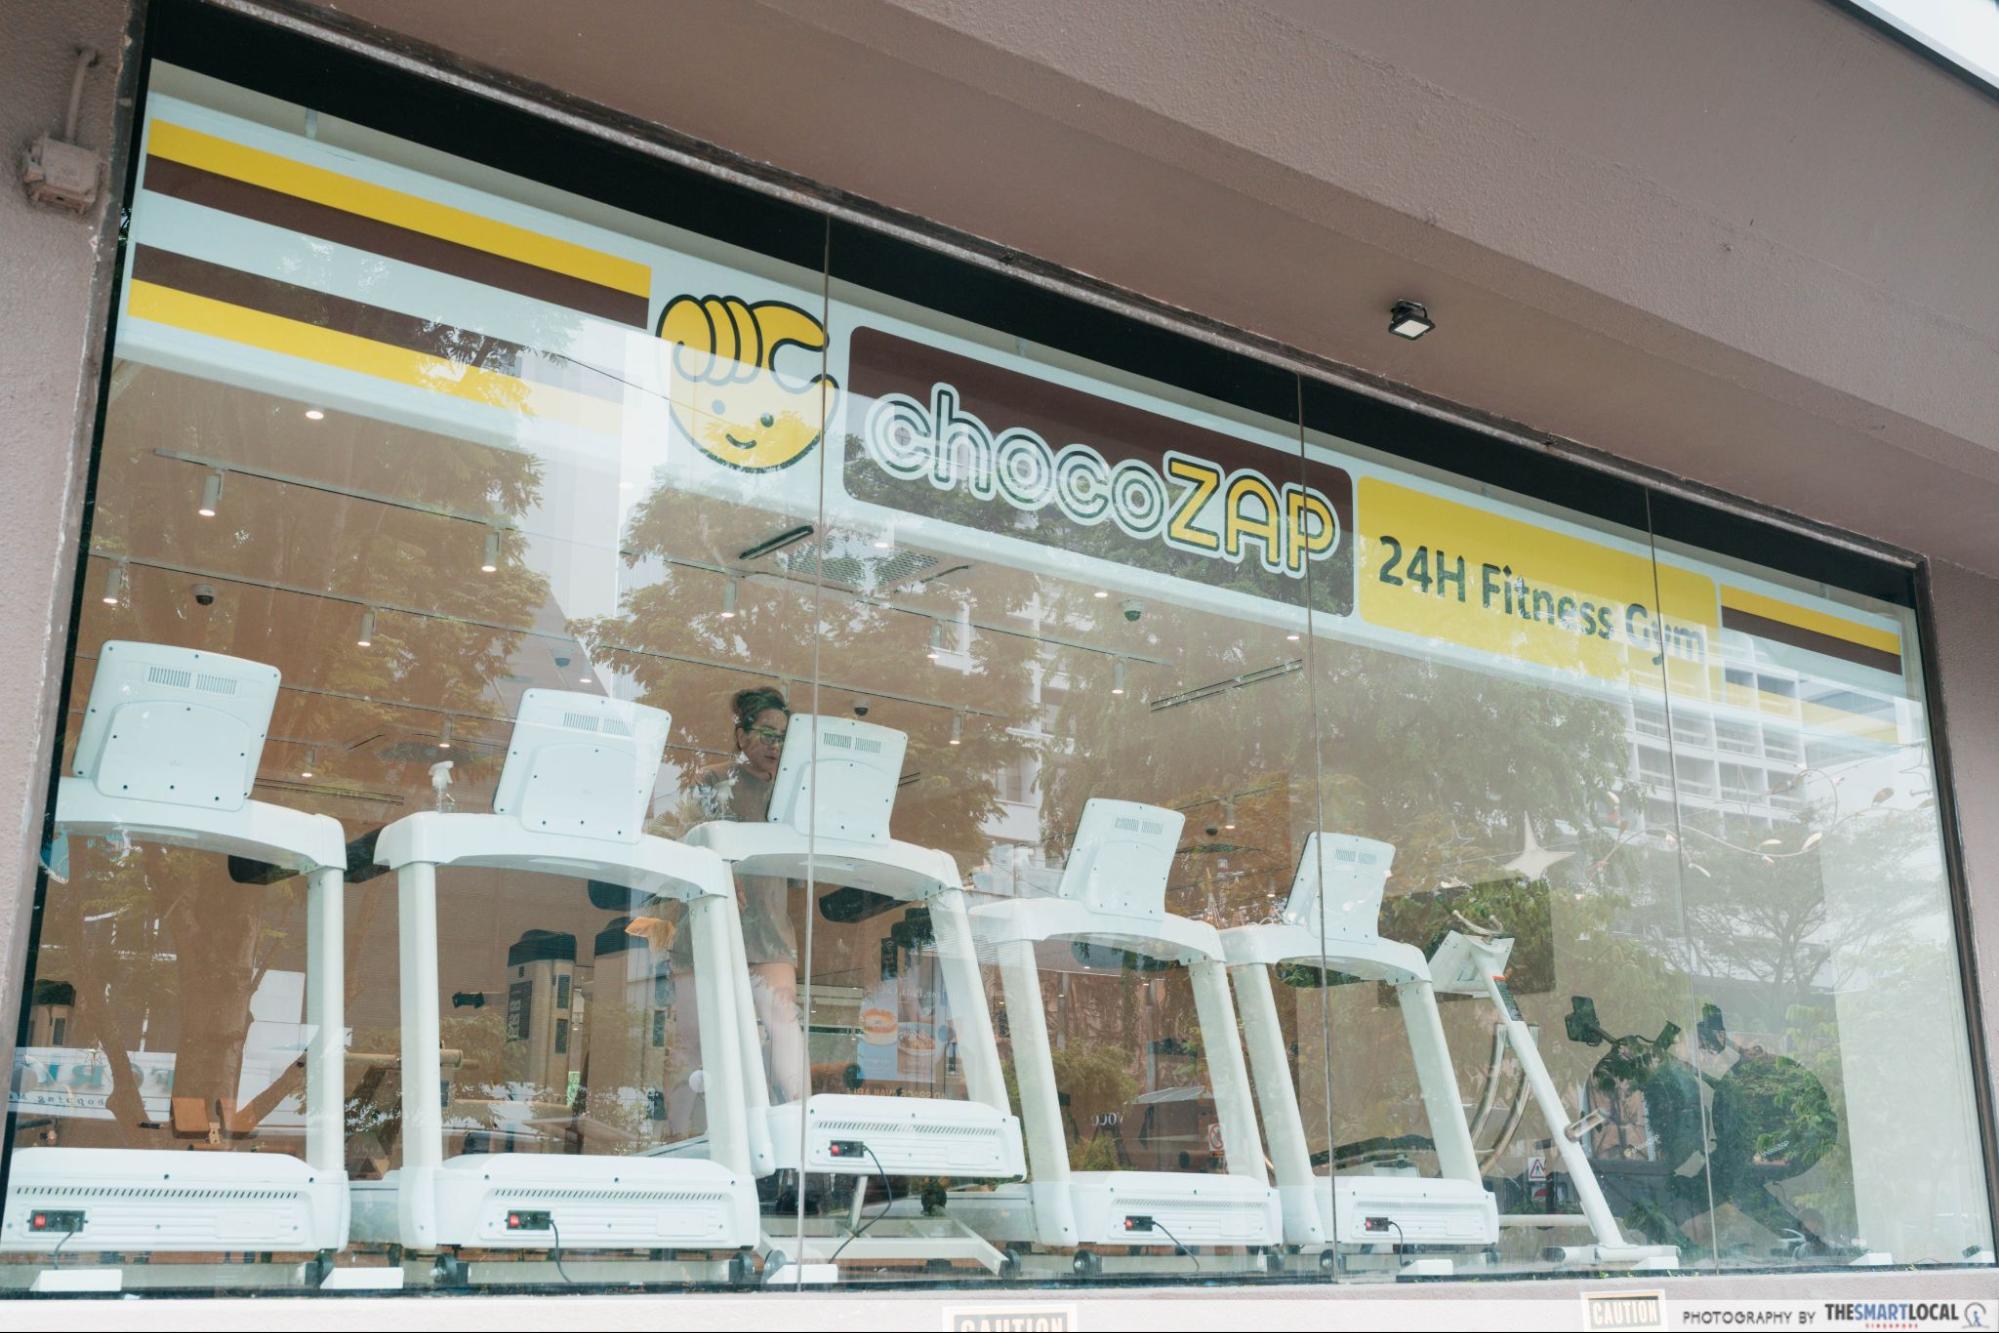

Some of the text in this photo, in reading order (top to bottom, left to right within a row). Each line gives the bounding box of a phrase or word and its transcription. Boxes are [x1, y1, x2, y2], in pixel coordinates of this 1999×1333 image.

[866, 383, 1340, 577] chocoZAP
[1379, 536, 1706, 667] 24H Fitness Gym
[1592, 1300, 1658, 1325] CAUTION
